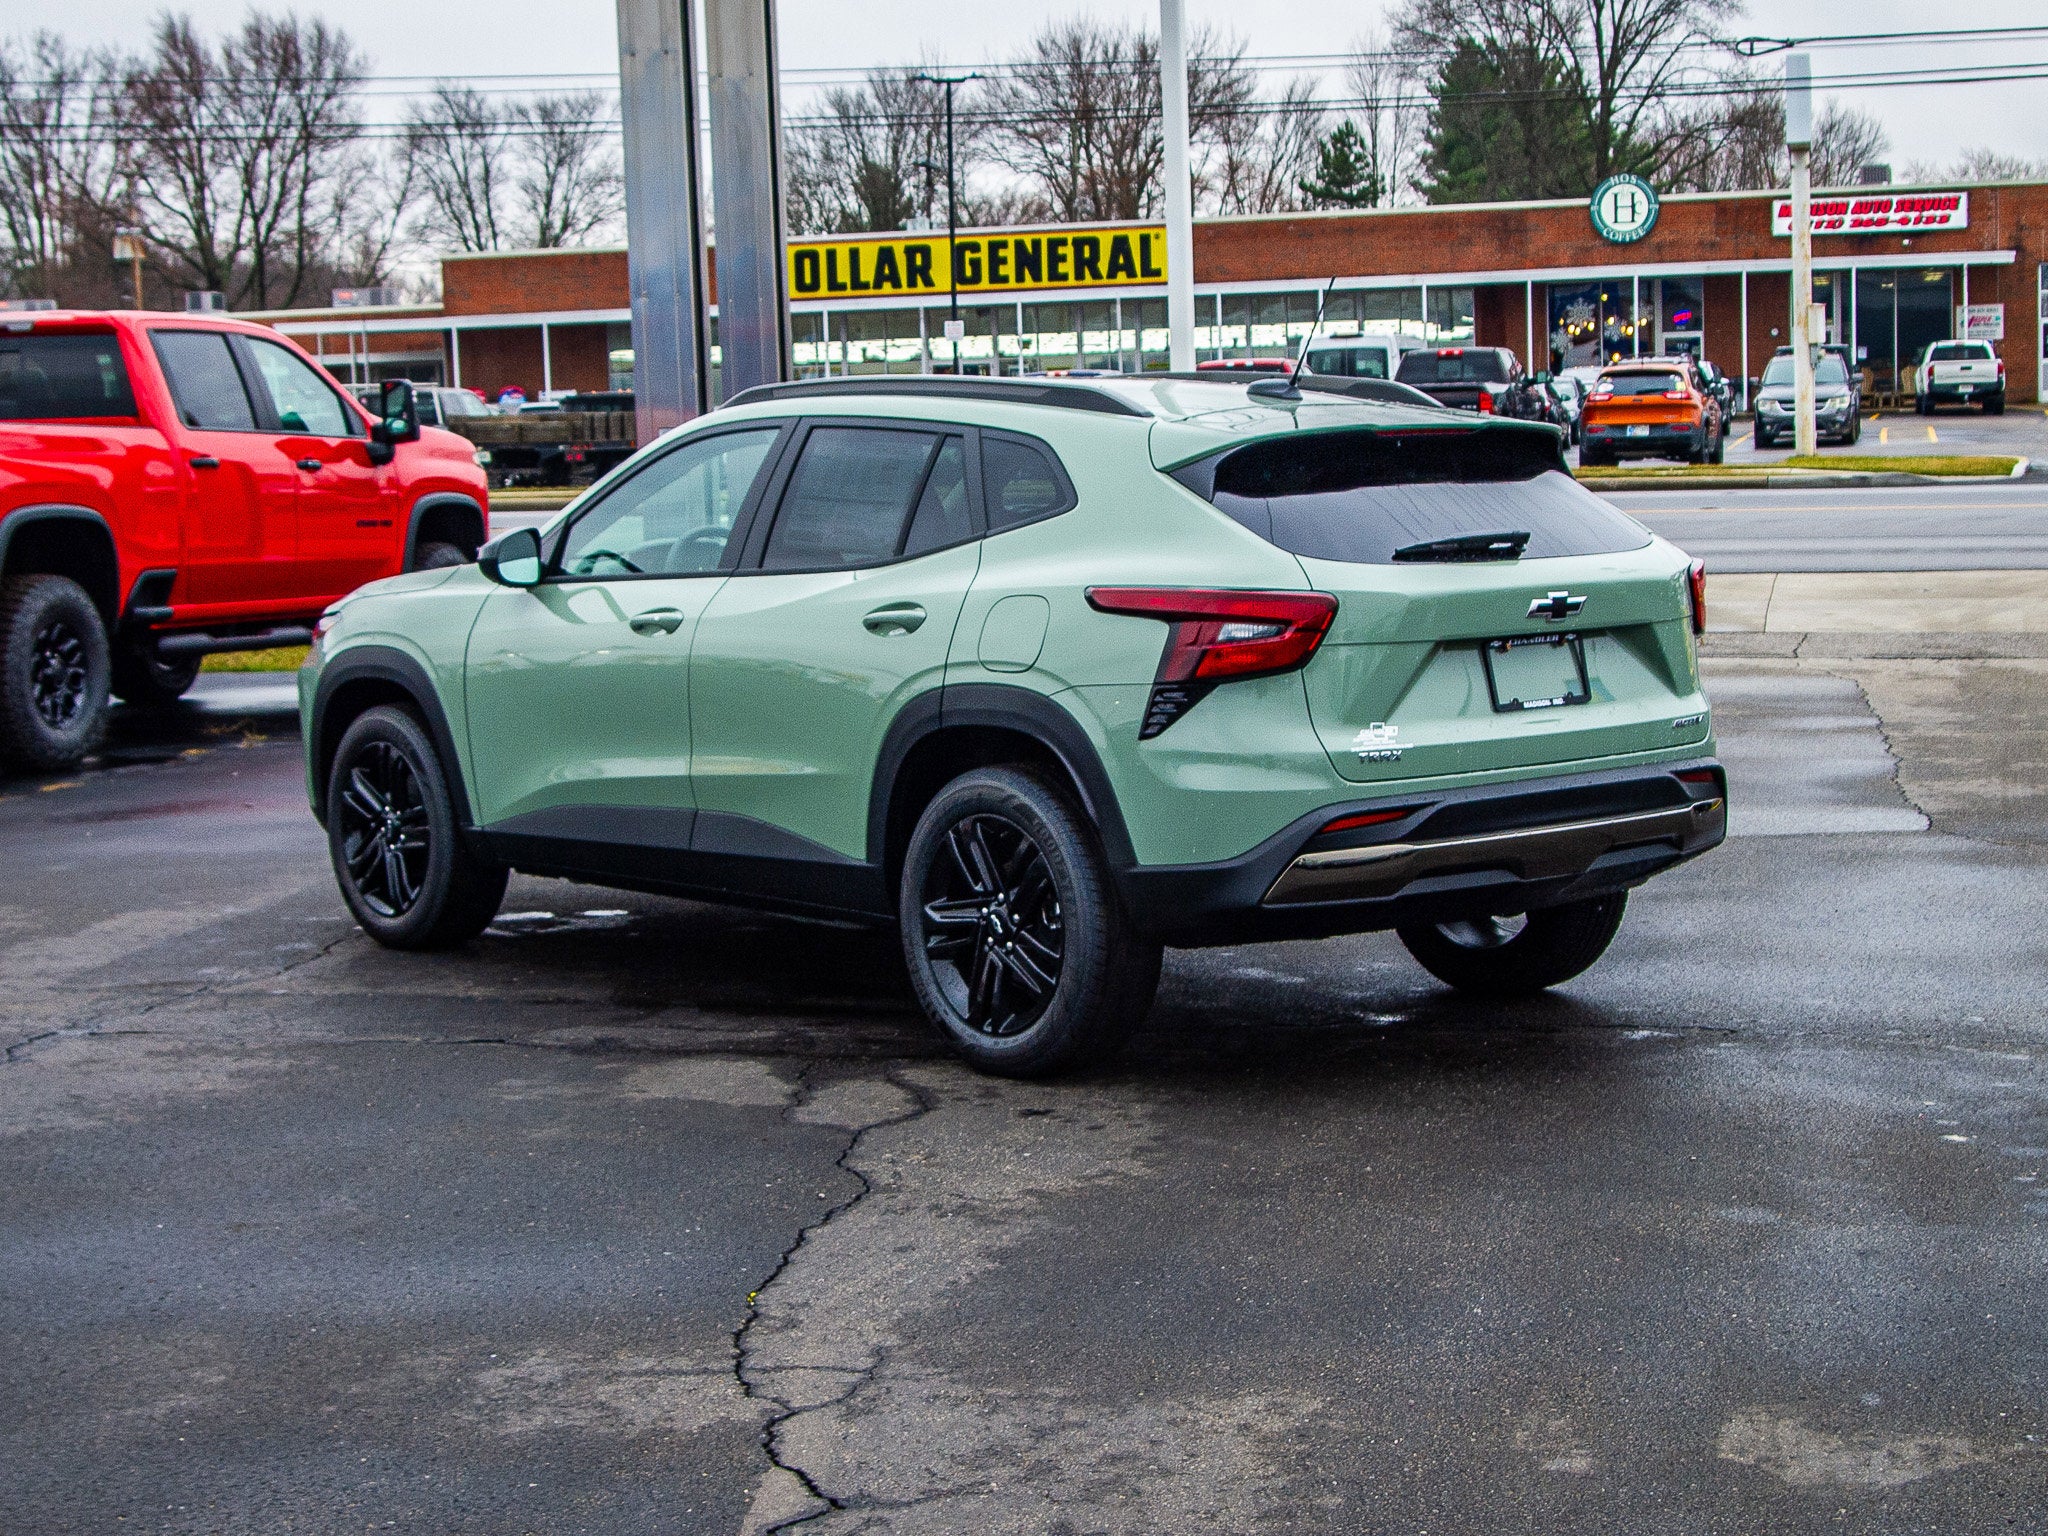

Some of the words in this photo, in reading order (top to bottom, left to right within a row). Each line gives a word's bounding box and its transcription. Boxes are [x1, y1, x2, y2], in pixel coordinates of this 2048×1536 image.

[1610, 173, 1637, 185] HOS
[1778, 201, 1849, 217] MISON
[1851, 198, 1893, 214] AUTO
[1894, 195, 1960, 213] SERVICE
[1603, 226, 1646, 242] COFFEE
[794, 243, 935, 293] OLLAR
[955, 233, 1162, 285] GENERAL
